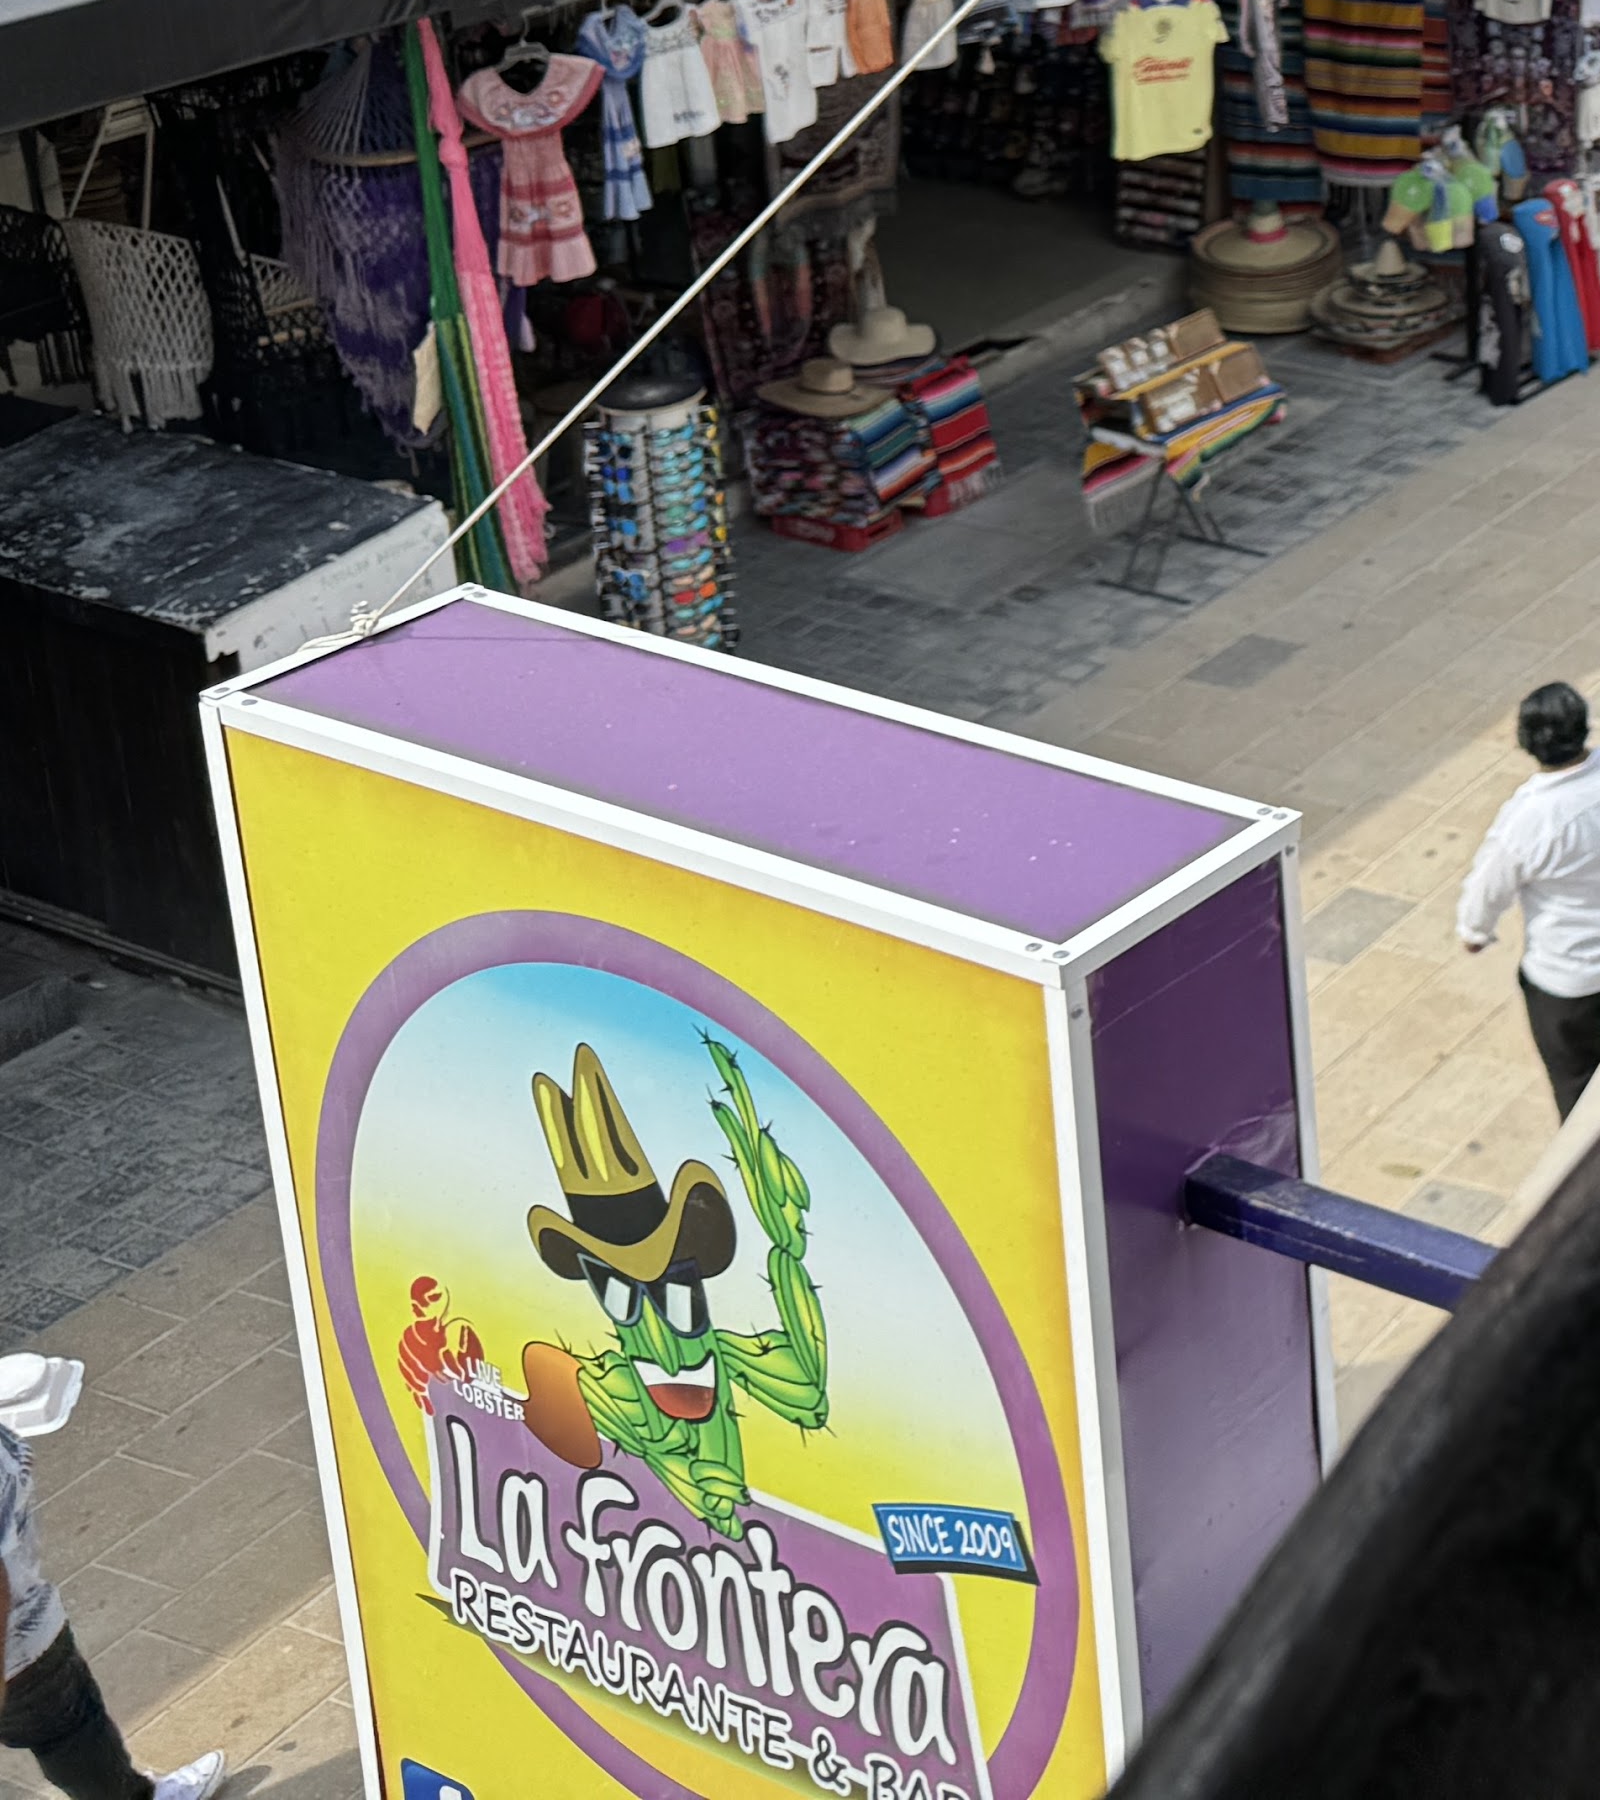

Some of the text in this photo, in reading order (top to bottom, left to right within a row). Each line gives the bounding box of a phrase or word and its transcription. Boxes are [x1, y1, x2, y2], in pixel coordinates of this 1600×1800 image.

[465, 1356, 503, 1388] LIVE
[453, 1378, 526, 1421] LOBSTER
[887, 1513, 1017, 1562] SINCE 2009
[450, 1419, 958, 1767] La frontera
[453, 1571, 968, 1800] RESTAURANTE & BA
